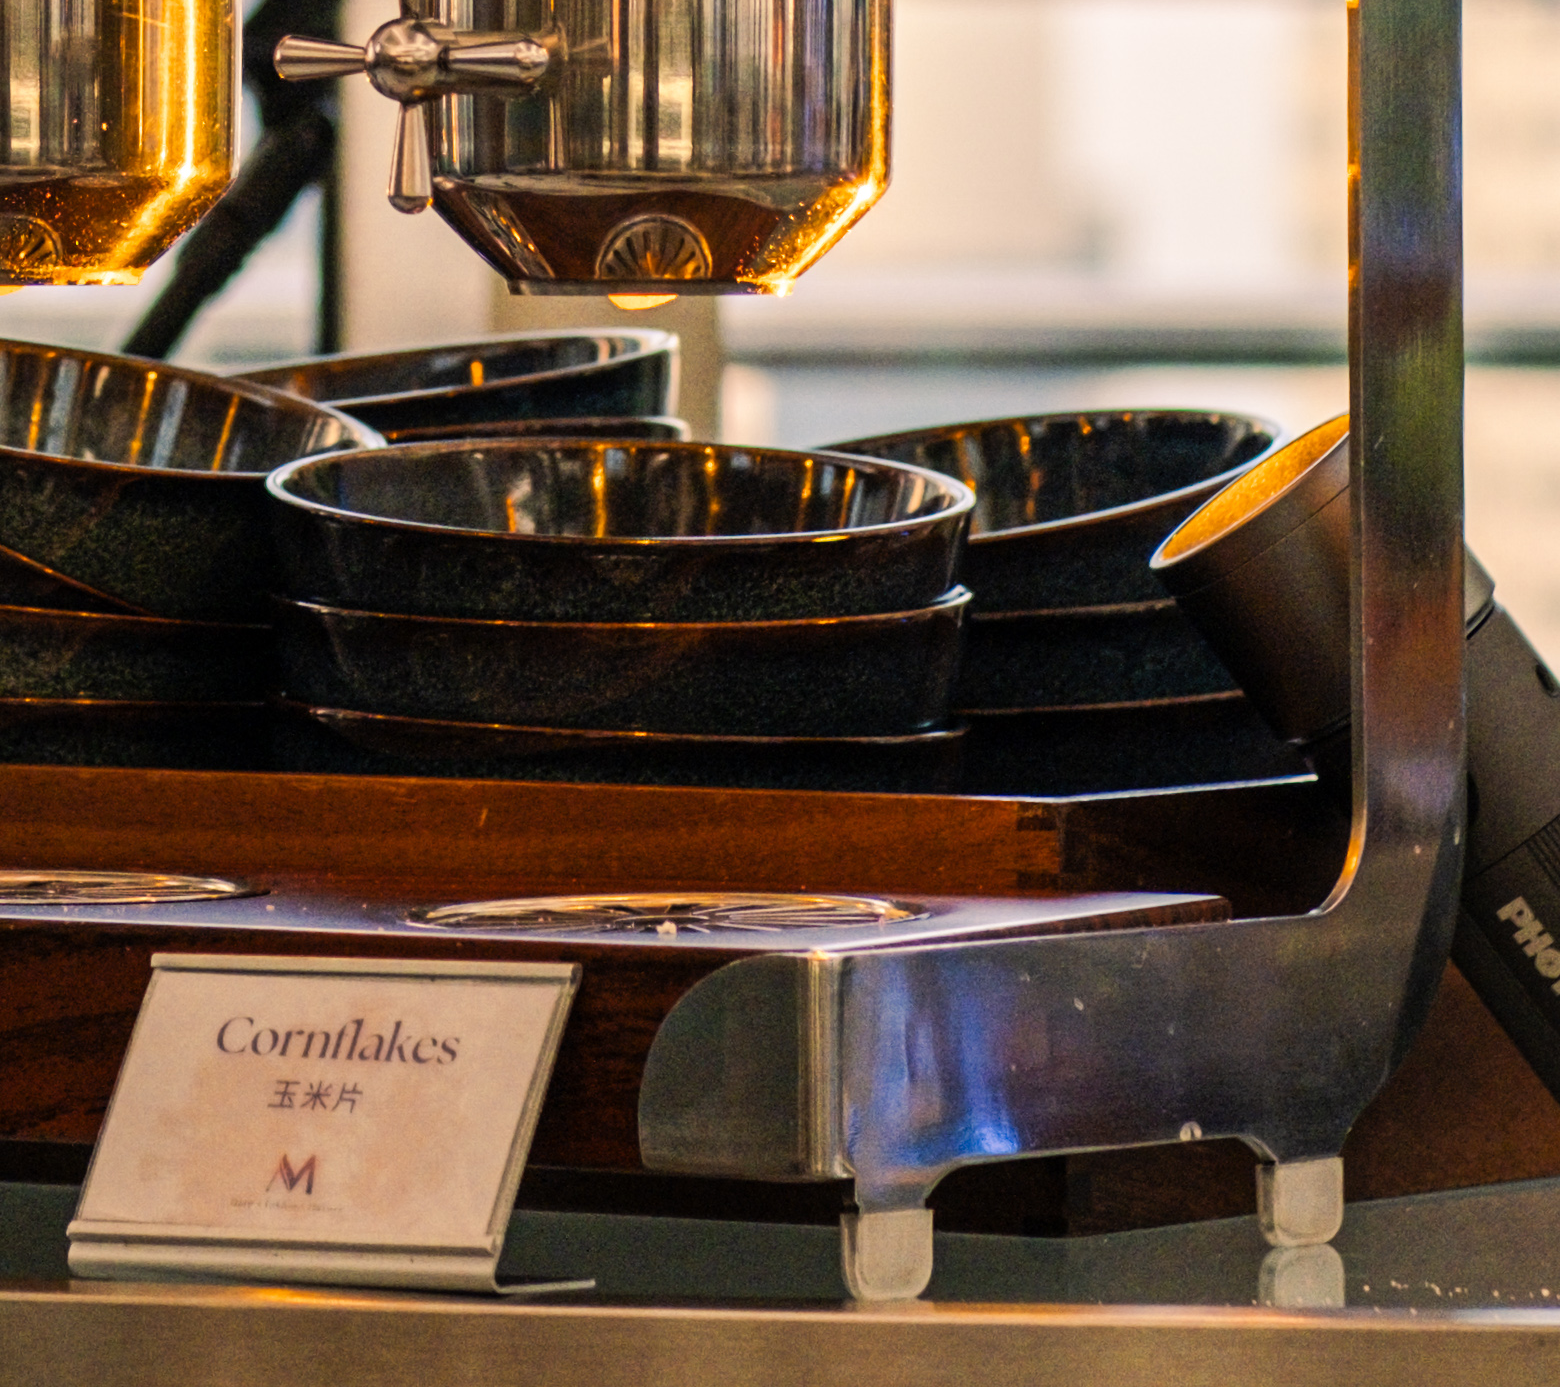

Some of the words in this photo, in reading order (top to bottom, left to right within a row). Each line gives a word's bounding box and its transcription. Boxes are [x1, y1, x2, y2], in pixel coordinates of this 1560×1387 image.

[216, 1016, 461, 1065] Cornflakes
[267, 1079, 364, 1114] 玉米片
